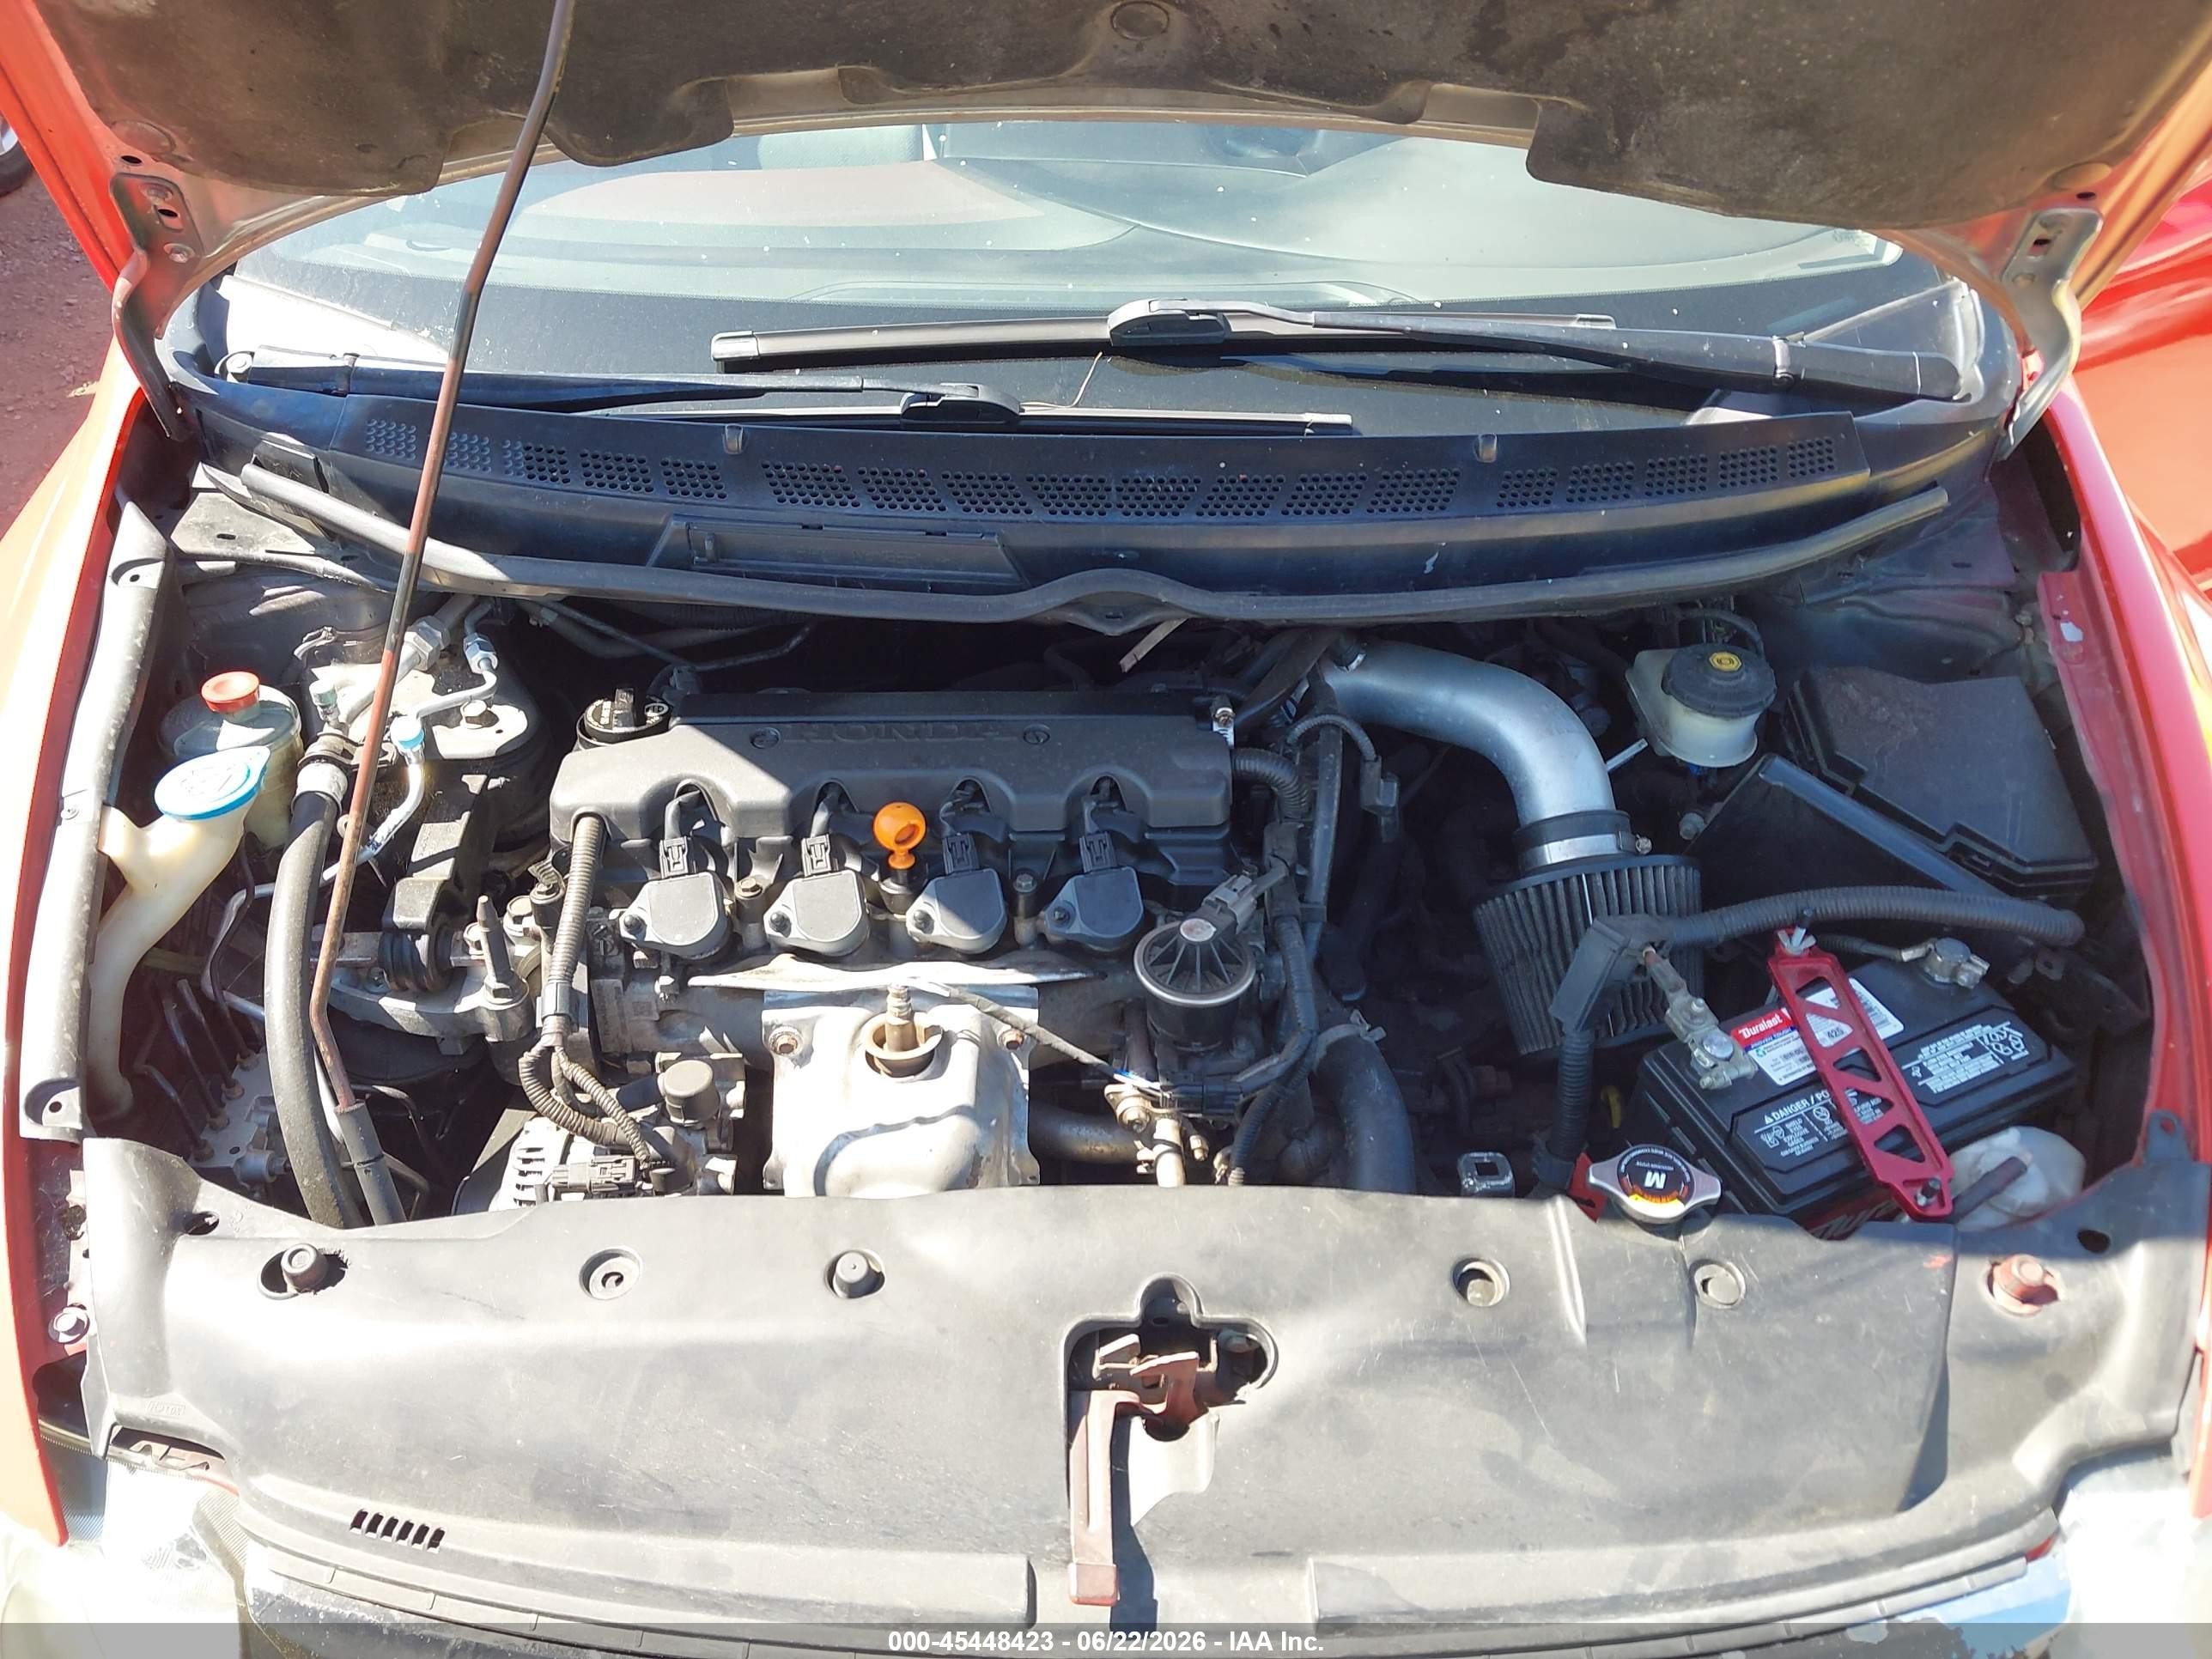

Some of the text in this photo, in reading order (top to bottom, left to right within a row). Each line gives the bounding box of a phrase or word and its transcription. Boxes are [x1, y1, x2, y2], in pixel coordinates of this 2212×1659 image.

[783, 722, 1018, 743] HONDA
[1740, 1013, 1784, 1039] Duralast
[1771, 1098, 1810, 1120] DANGER
[1814, 1089, 1831, 1102] PO
[1644, 1170, 1666, 1189] M
